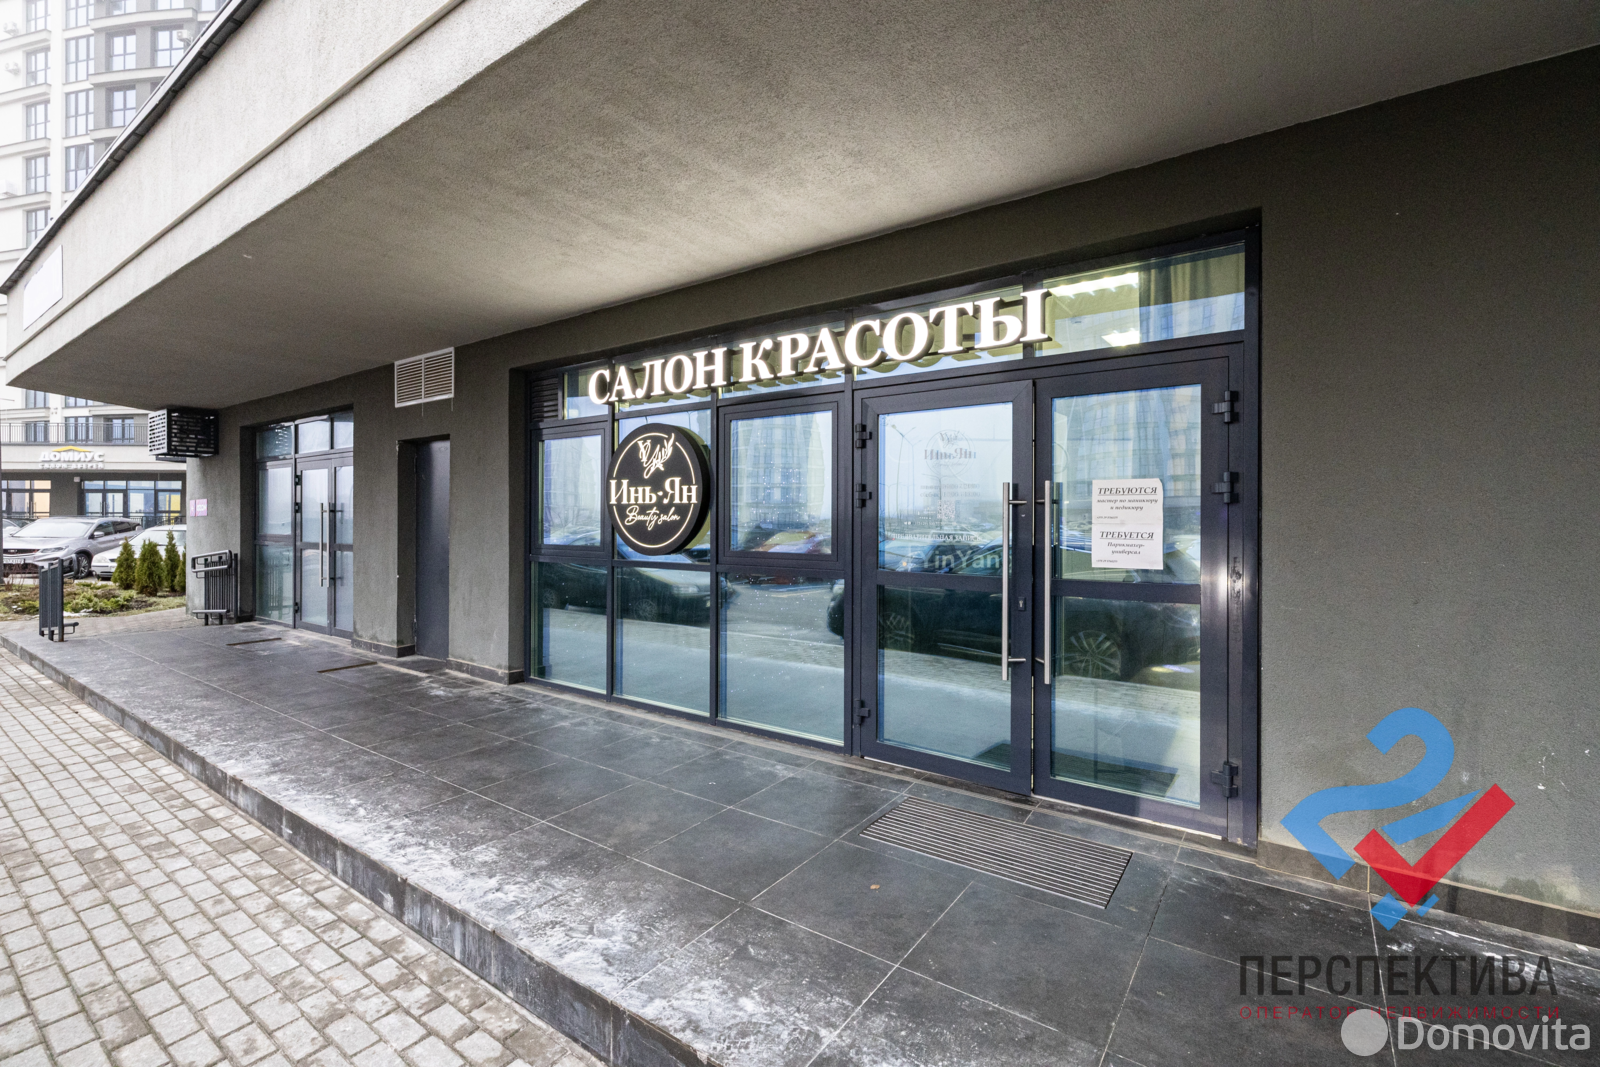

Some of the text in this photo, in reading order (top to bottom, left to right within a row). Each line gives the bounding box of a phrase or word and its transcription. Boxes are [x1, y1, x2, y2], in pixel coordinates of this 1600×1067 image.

[588, 288, 1051, 405] САЛОН КРАСОТЫ
[39, 451, 105, 463] ДОМИУС
[1098, 487, 1157, 495] ТРЕБУЮТСЯ
[625, 505, 681, 531] Beauty salon
[1100, 530, 1154, 540] ТРЕБУЕТСЯ
[921, 549, 1011, 572] YinYan
